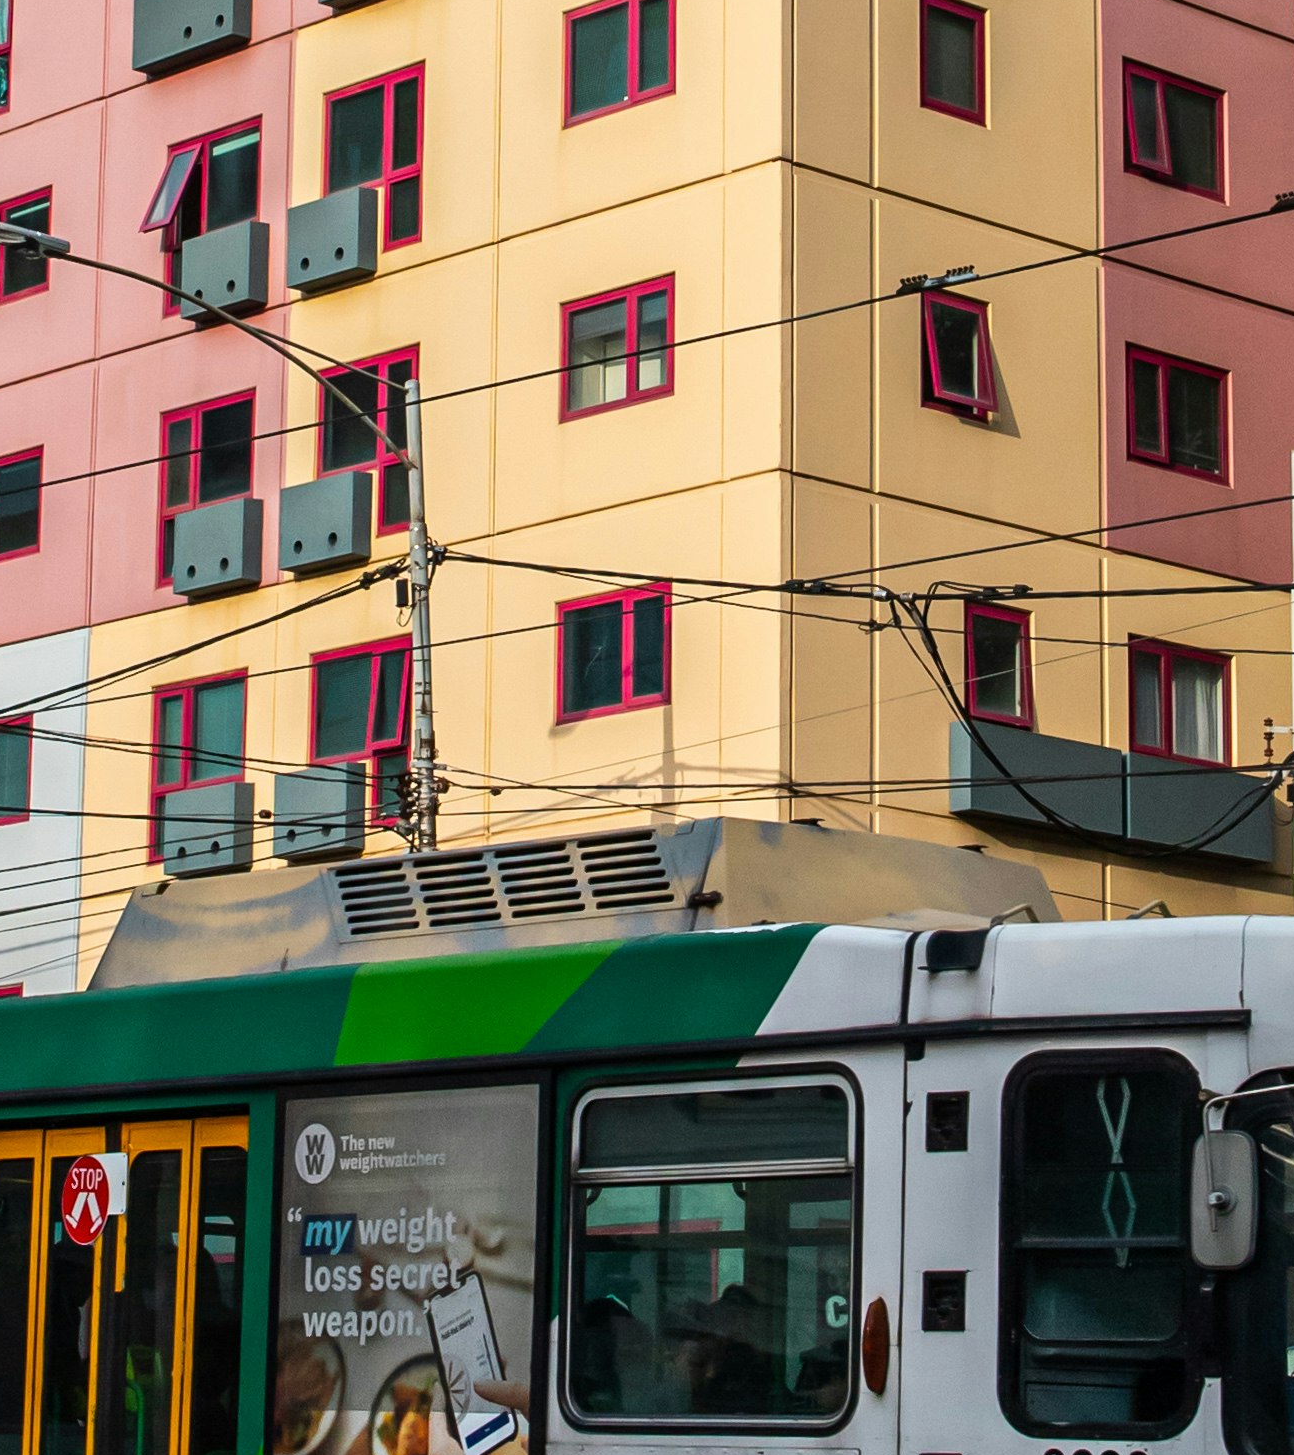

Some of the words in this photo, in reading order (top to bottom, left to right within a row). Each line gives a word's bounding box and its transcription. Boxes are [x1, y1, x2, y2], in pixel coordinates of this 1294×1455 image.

[340, 1135, 365, 1152] The
[368, 1137, 396, 1150] new
[339, 1149, 446, 1174] weightwatchers
[71, 1167, 104, 1190] STOP
[358, 1207, 458, 1253] weight
[304, 1257, 362, 1292] loss
[369, 1261, 462, 1291] secret
